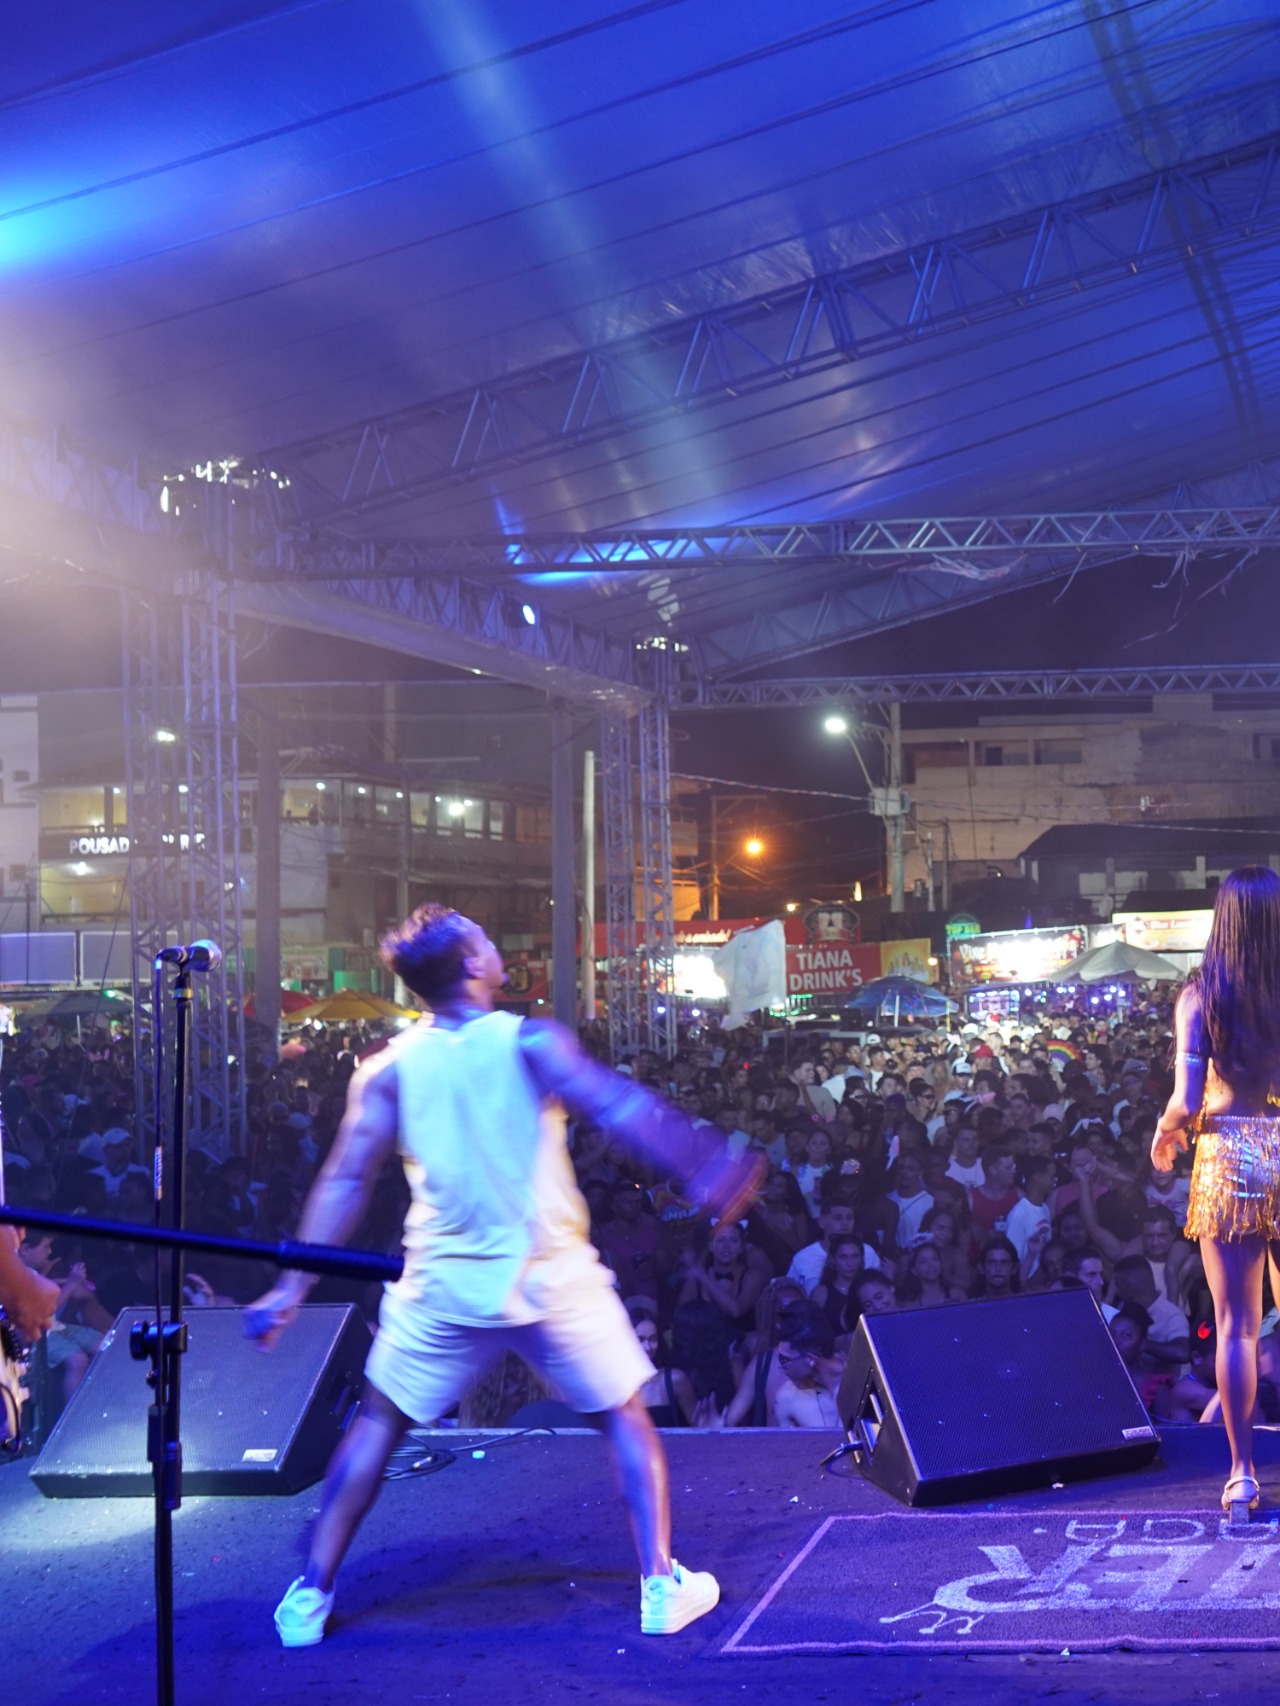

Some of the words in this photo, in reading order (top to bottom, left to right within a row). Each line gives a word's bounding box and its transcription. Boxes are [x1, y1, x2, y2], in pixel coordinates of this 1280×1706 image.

[69, 836, 135, 855] POUSAD
[796, 949, 853, 970] TIANA
[789, 968, 863, 992] DRINK'S
